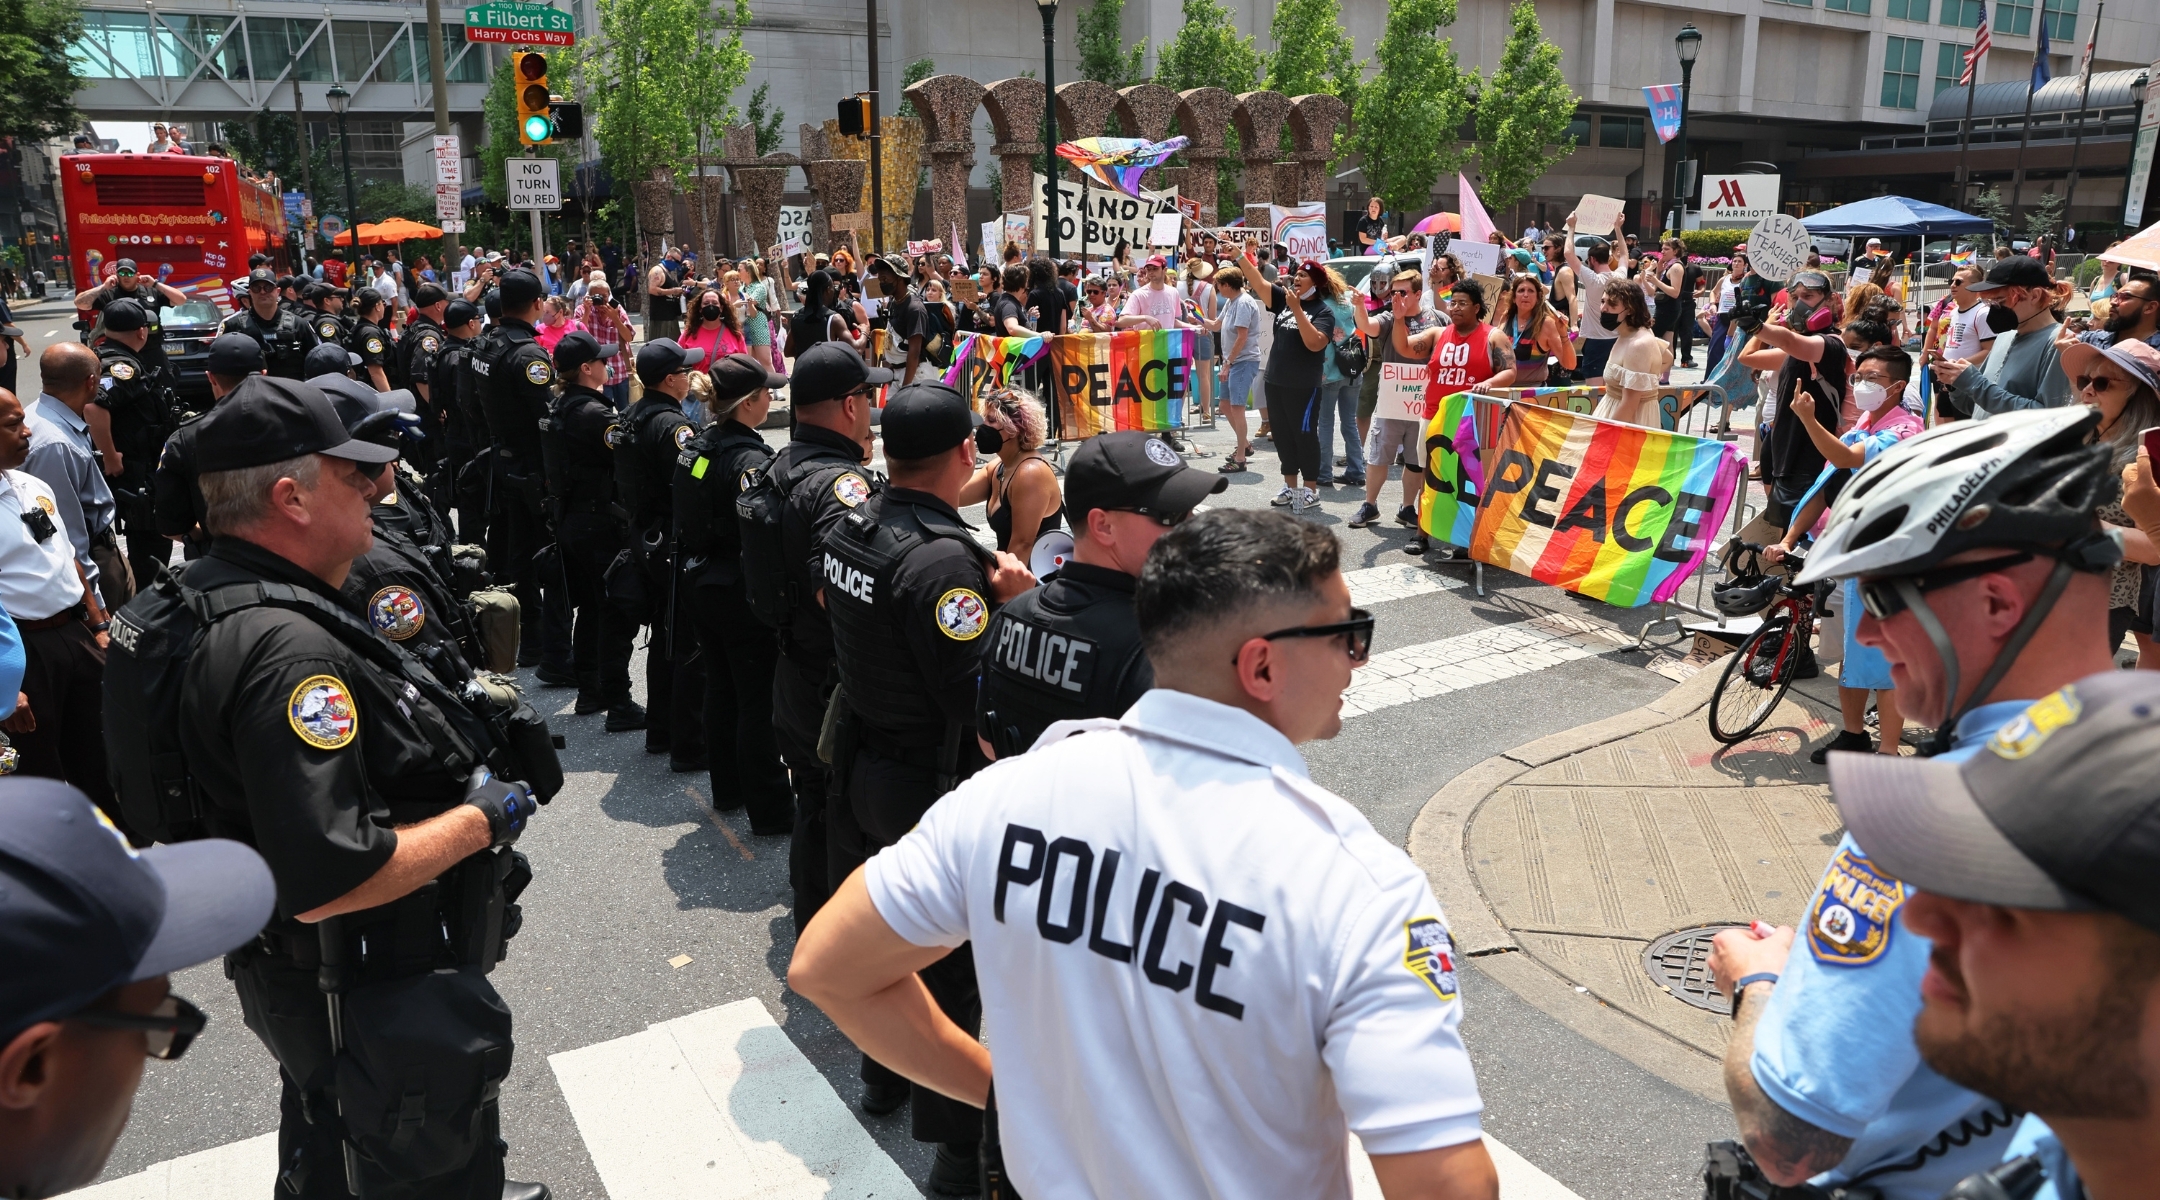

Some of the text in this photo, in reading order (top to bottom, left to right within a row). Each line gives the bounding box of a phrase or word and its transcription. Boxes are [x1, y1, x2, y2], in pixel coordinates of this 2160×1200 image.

[487, 10, 568, 29] Filbert St
[474, 28, 566, 44] Harry Ochs Way
[436, 149, 446, 158] NO
[76, 164, 91, 172] 102
[206, 166, 220, 174] 102
[523, 164, 542, 174] NO
[437, 185, 446, 193] NO
[516, 180, 550, 189] TURN
[514, 194, 556, 204] ON RED
[79, 213, 138, 226] Philadelphia
[1716, 210, 1774, 218] MARRIOTT
[1260, 231, 1268, 242] IS
[1762, 218, 1809, 254] LEAVE
[1290, 236, 1326, 255] DANCE
[204, 259, 226, 268] Hop Off
[206, 252, 216, 260] Hop
[1462, 250, 1483, 260] month
[1749, 250, 1788, 280] ALONE
[1440, 342, 1470, 366] GO
[471, 356, 490, 377] POLICE
[1062, 358, 1188, 406] PEACE
[1437, 368, 1466, 386] RED
[1396, 384, 1398, 392] I
[1926, 448, 2012, 535] PHILADELPH
[736, 503, 752, 520] POLICE
[1482, 450, 1716, 563] PEACE
[823, 552, 875, 604] POLICE
[109, 614, 141, 651] POLICE
[996, 615, 1092, 692] POLICE
[1822, 866, 1896, 924] POLICE
[994, 823, 1266, 1022] POLICE
